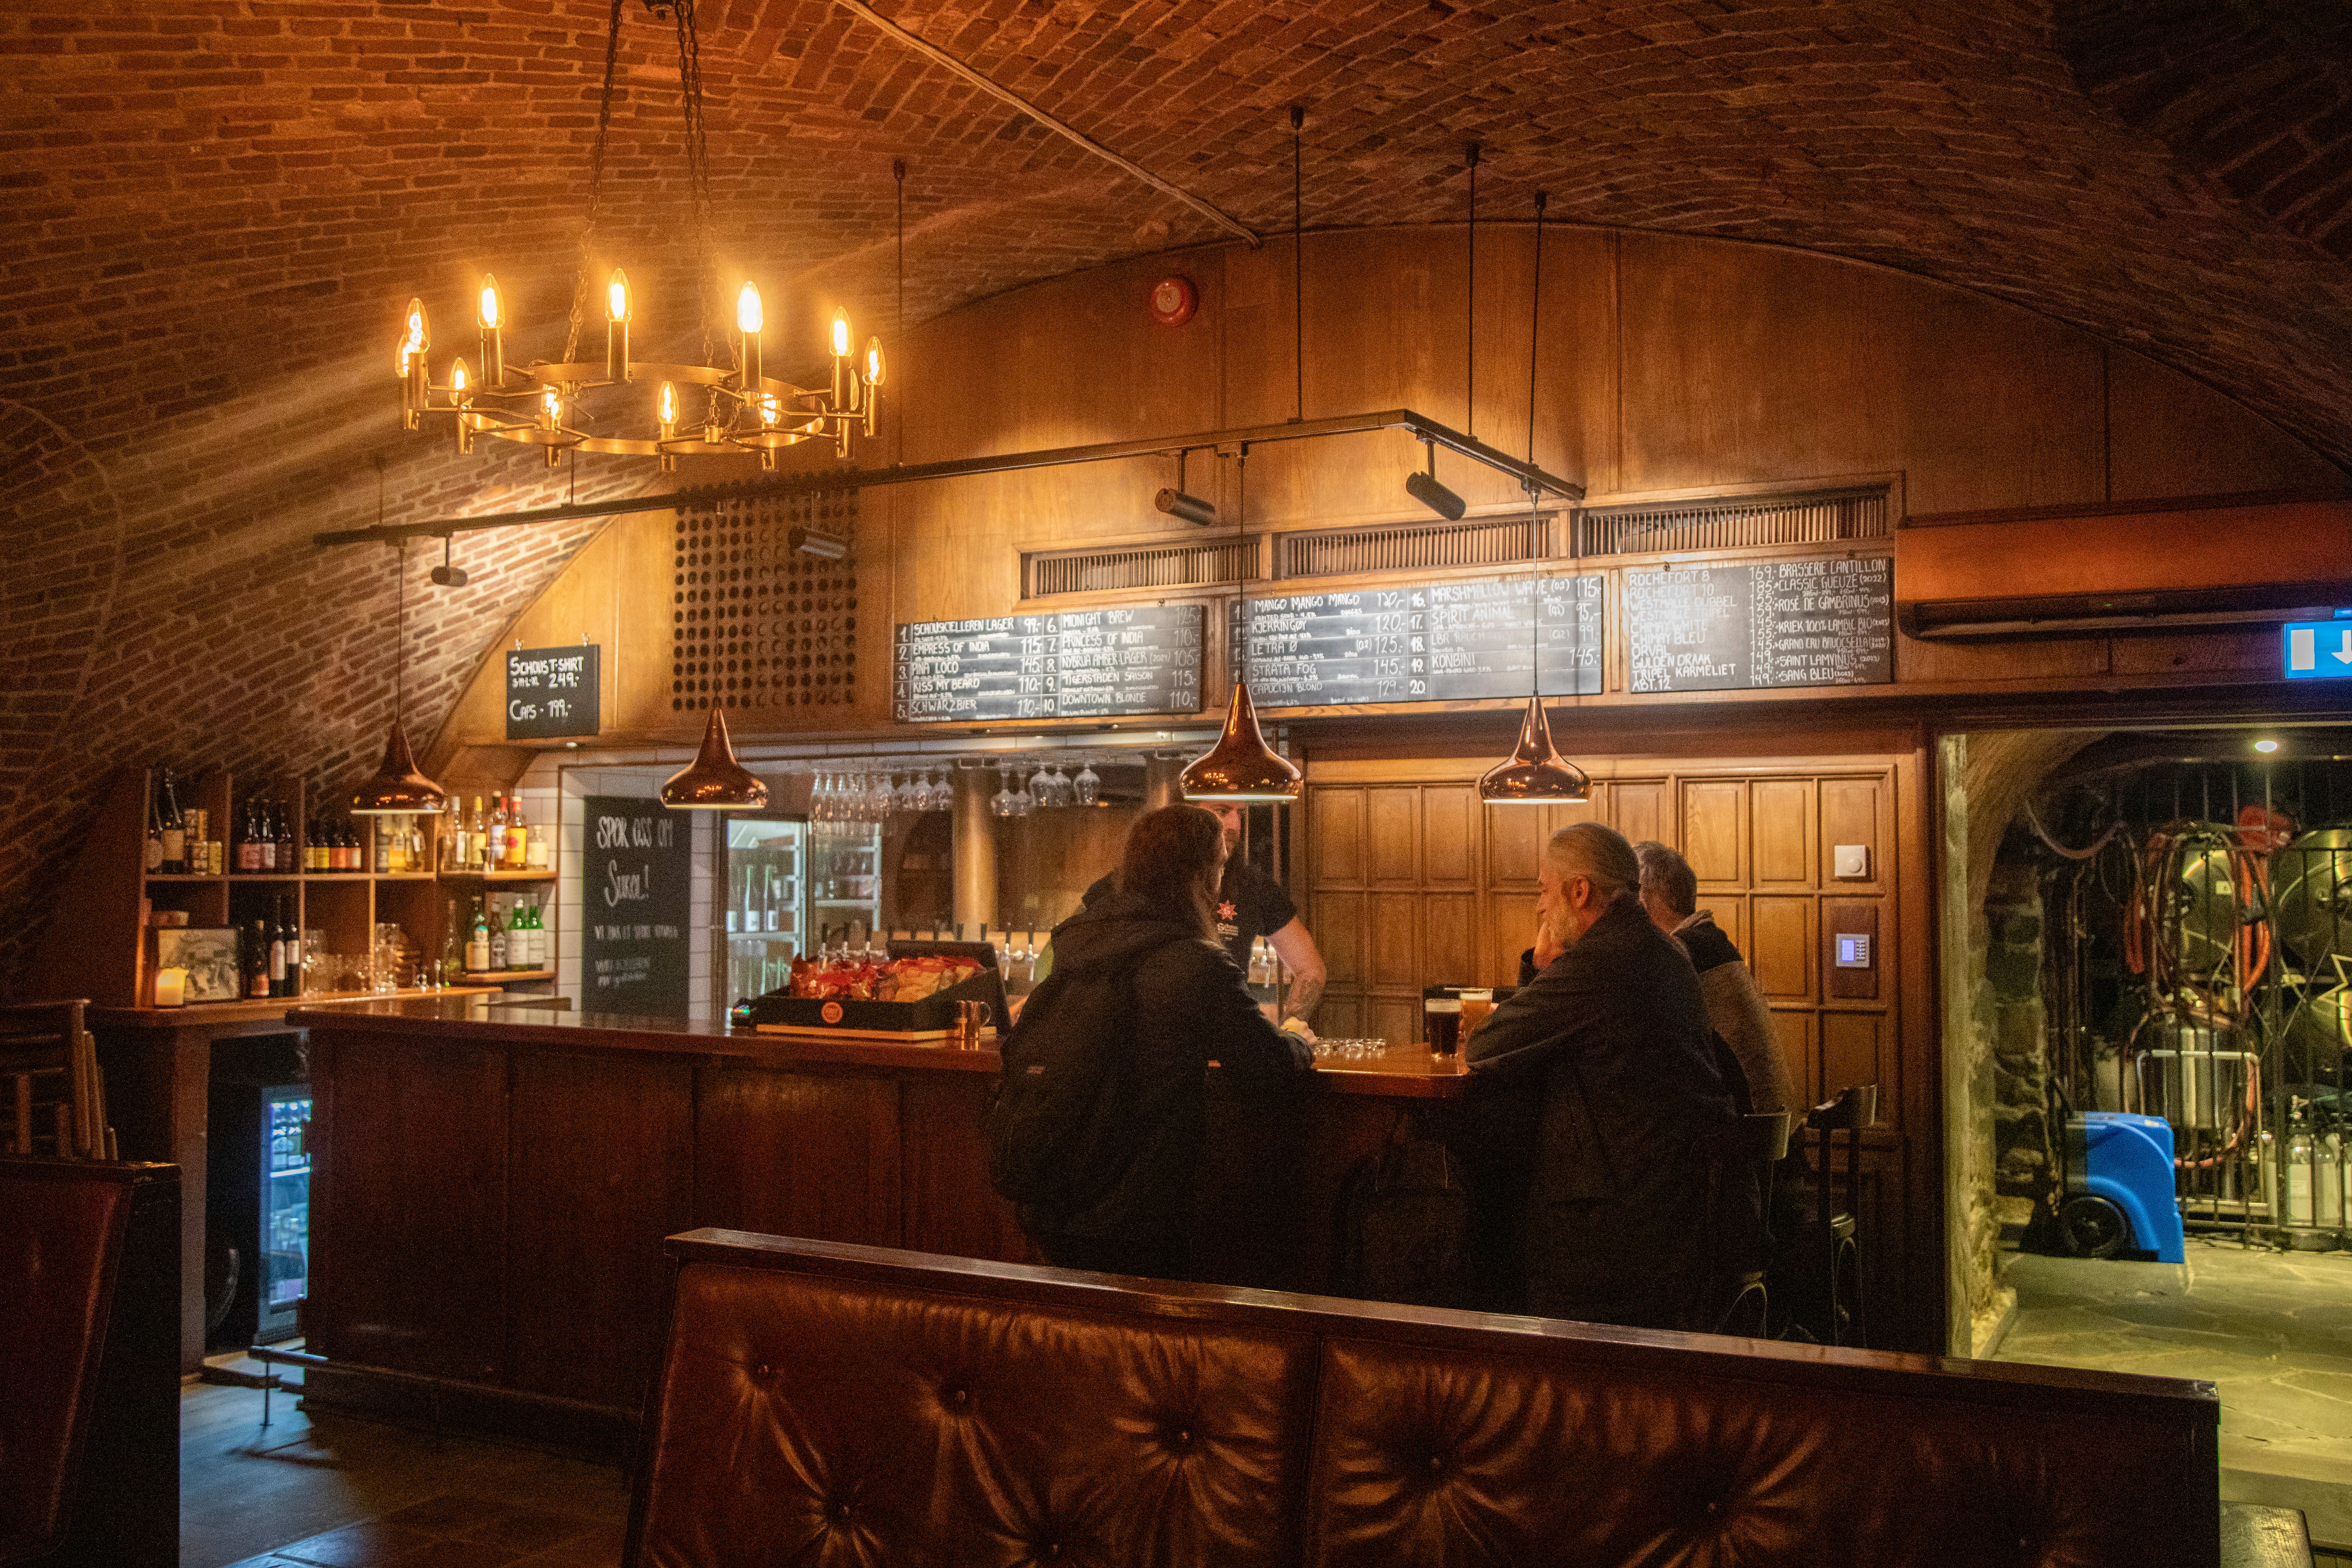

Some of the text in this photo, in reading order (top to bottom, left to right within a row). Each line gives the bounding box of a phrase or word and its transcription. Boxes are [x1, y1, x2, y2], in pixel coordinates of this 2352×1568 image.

[1780, 561, 1827, 578] BRASSERIE
[1629, 570, 1699, 586] ROCHEFORT
[1702, 570, 1709, 582] 8
[1779, 578, 1819, 592] CLASSIC
[1821, 574, 1858, 589] GUEUZE
[1432, 583, 1508, 603] MARSHMALLOW
[1630, 583, 1699, 600] ROCHEFORT
[1702, 583, 1714, 597] 10
[1255, 599, 1287, 613] MANGO
[1291, 596, 1323, 611] MANGO
[1328, 593, 1360, 606] MANGO
[1630, 597, 1690, 611] WESTMALLE
[1694, 596, 1737, 607] DUBBEL
[1804, 597, 1815, 611] DE
[1819, 595, 1870, 610] GAMBRINUS
[1063, 612, 1101, 628] MIDNIGHT
[1108, 610, 1134, 624] BREW
[1431, 608, 1468, 625] SPIRIT
[1473, 606, 1515, 621] ANIMAL
[986, 617, 1014, 631] LAGER
[1252, 619, 1307, 633] KJERRINGØY
[1779, 620, 1803, 633] KRIEK
[1806, 620, 1826, 632] 100%
[1828, 619, 1855, 630] LAMBIC
[1858, 618, 1871, 629] BIO
[1061, 634, 1102, 648] PRINCESS
[1108, 633, 1118, 644] OF
[1122, 631, 1143, 643] INDIA
[1432, 632, 1449, 645] LBR
[1631, 632, 1671, 646] CHIMAY
[1674, 632, 1705, 644] BLEU
[1778, 639, 1803, 650] GRAND
[1806, 638, 1820, 649] CRU
[913, 643, 950, 654] EMPRESS
[953, 642, 964, 652] OF
[969, 641, 990, 652] INDIA
[1251, 642, 1285, 656] LETRA
[1632, 644, 1671, 658] ORVAL
[935, 661, 959, 674] LOCO
[1062, 654, 1091, 668] NYBRUA
[1093, 652, 1118, 665] AMBER
[1120, 652, 1147, 665] LAGER
[1432, 653, 1475, 668] KONBINI
[1632, 655, 1674, 669] GULDEN
[1677, 654, 1711, 666] DRAAK
[1780, 655, 1808, 666] SAINT
[1253, 664, 1290, 676] STRATA
[1296, 663, 1317, 675] FOG
[1632, 668, 1671, 681] TRIPEL
[1675, 663, 1736, 677] KARMELIET
[1781, 668, 1807, 682] SANG
[1810, 668, 1834, 680] BLEU
[913, 681, 932, 693] KISS
[935, 680, 950, 690] MY
[952, 678, 980, 690] BEARD
[1062, 672, 1119, 685] TIGERSTADEN
[1125, 671, 1153, 681] SAISON
[1296, 682, 1323, 692] BLOND
[1062, 693, 1110, 705] DOWNTOWN
[1116, 692, 1146, 703] BLONDE
[909, 699, 977, 714] SCHWARZBIER
